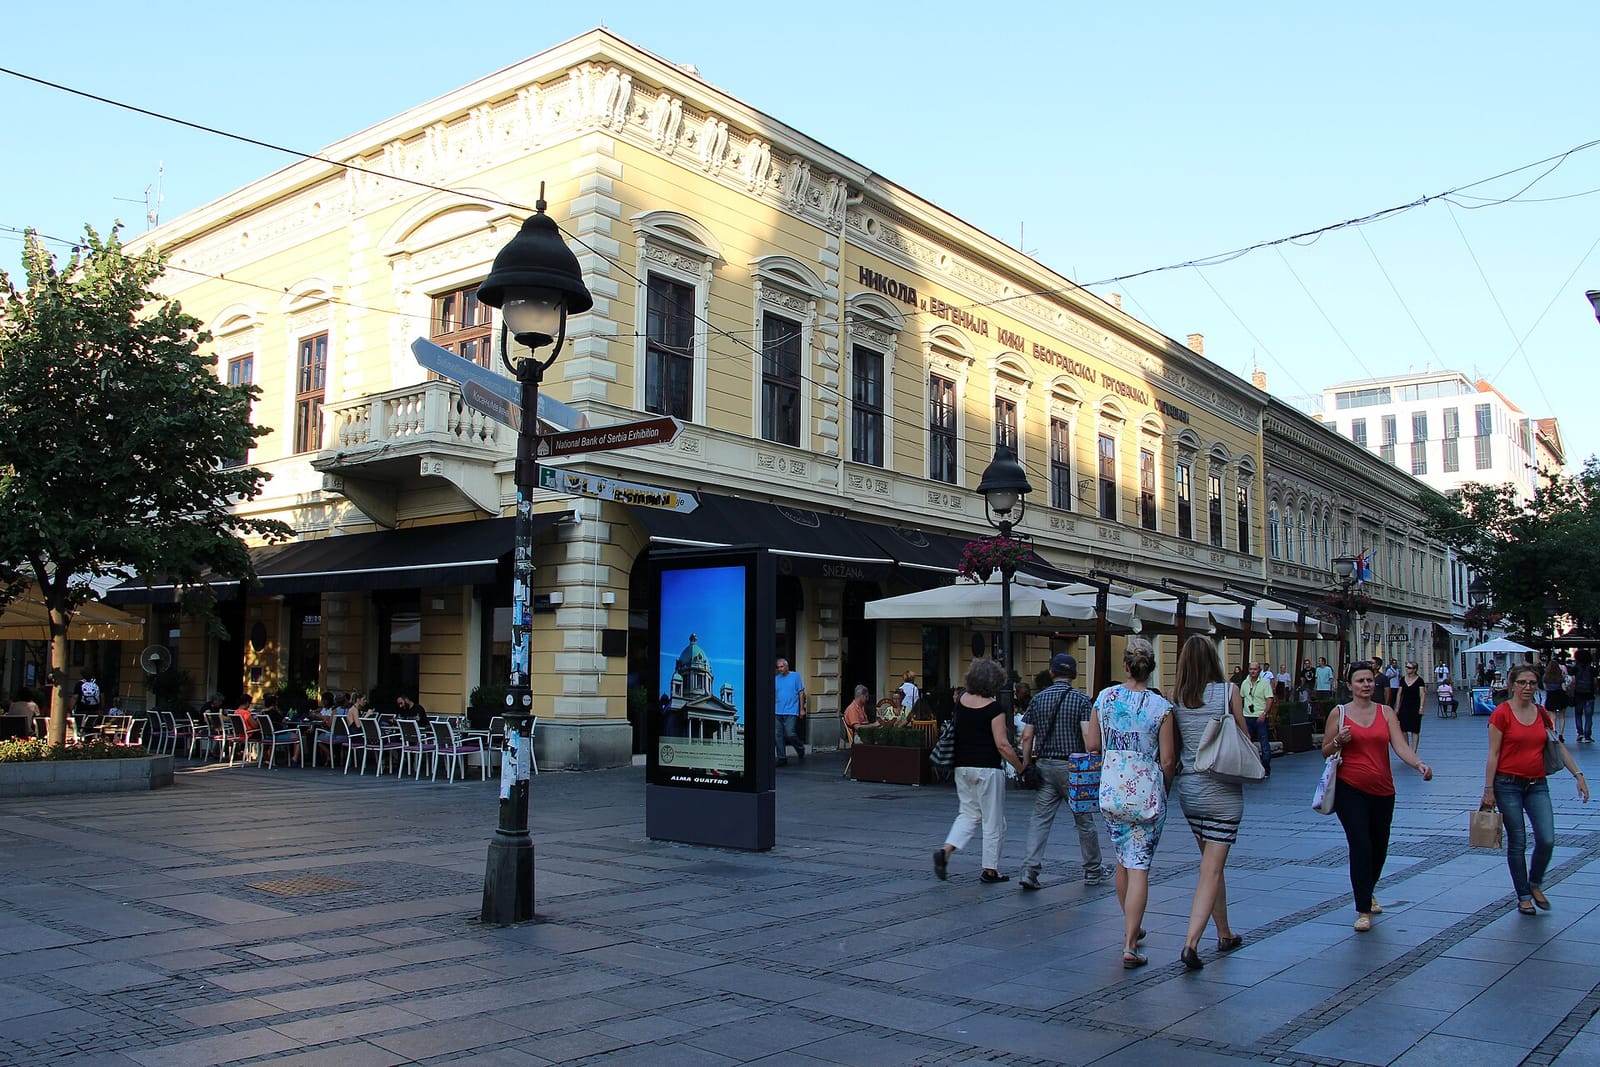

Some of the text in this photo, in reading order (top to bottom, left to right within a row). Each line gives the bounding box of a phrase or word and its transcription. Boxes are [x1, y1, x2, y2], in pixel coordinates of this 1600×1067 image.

[859, 265, 918, 307] НИКОЛА
[930, 297, 989, 338] ЕВГЕНИЈА
[997, 327, 1025, 353] КИКИ
[556, 428, 659, 450] National Bank of Serbia Exhibition
[694, 777, 729, 785] QUATTRO
